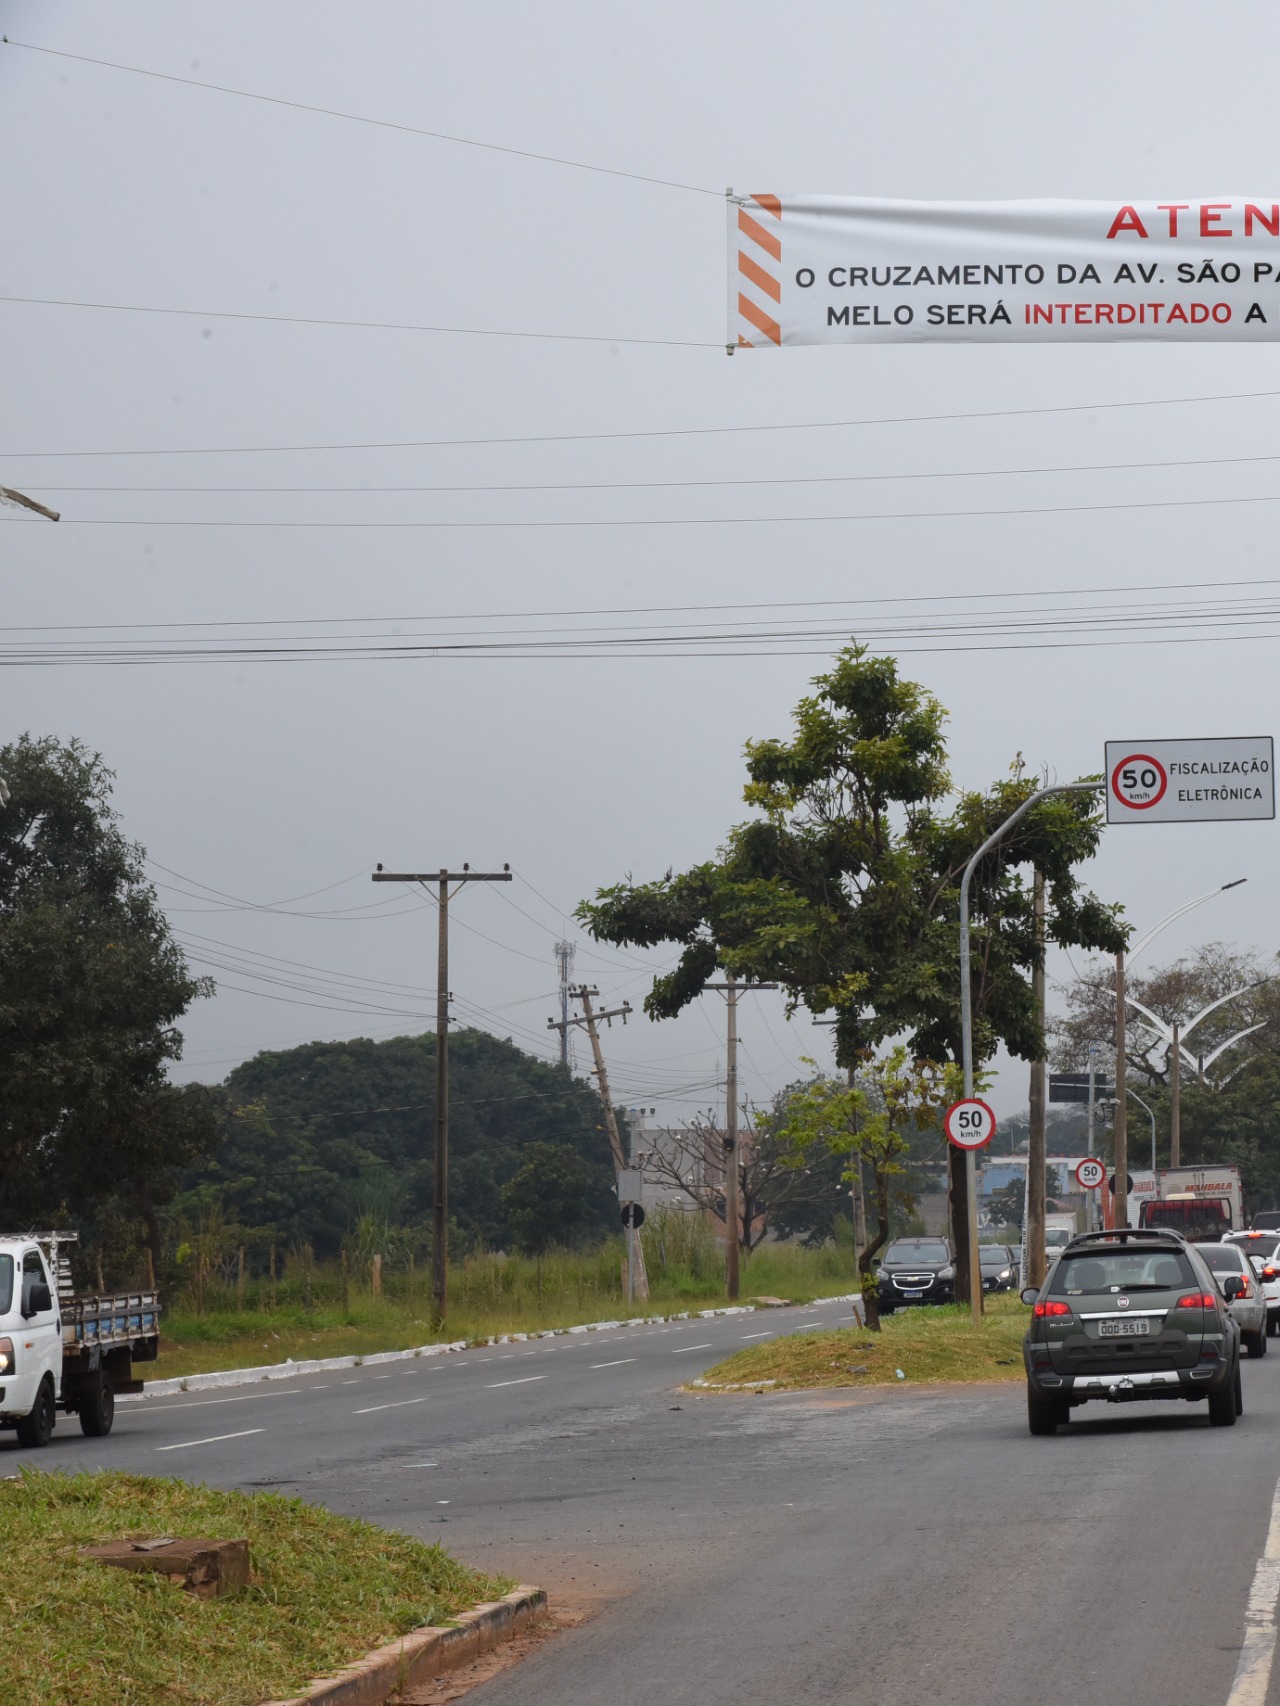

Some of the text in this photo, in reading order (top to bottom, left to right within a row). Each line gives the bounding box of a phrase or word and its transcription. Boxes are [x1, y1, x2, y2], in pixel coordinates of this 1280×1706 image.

[795, 268, 816, 289] O
[828, 263, 1045, 288] CRUZAMENTO
[1058, 263, 1102, 285] DA
[1113, 263, 1165, 284] AV.
[1177, 258, 1241, 284] SÃO
[826, 305, 915, 327] MELO
[926, 300, 1012, 325] SERÁ
[1024, 302, 1233, 325] INTERDITADO
[1245, 302, 1267, 323] A
[1170, 758, 1269, 776] FISCALIZAÇÃO
[1122, 769, 1157, 789] 50
[1129, 792, 1150, 800] km/h
[1178, 785, 1263, 802] ELETRÔNICA
[958, 1110, 983, 1128] 50
[1083, 1166, 1098, 1177] 50
